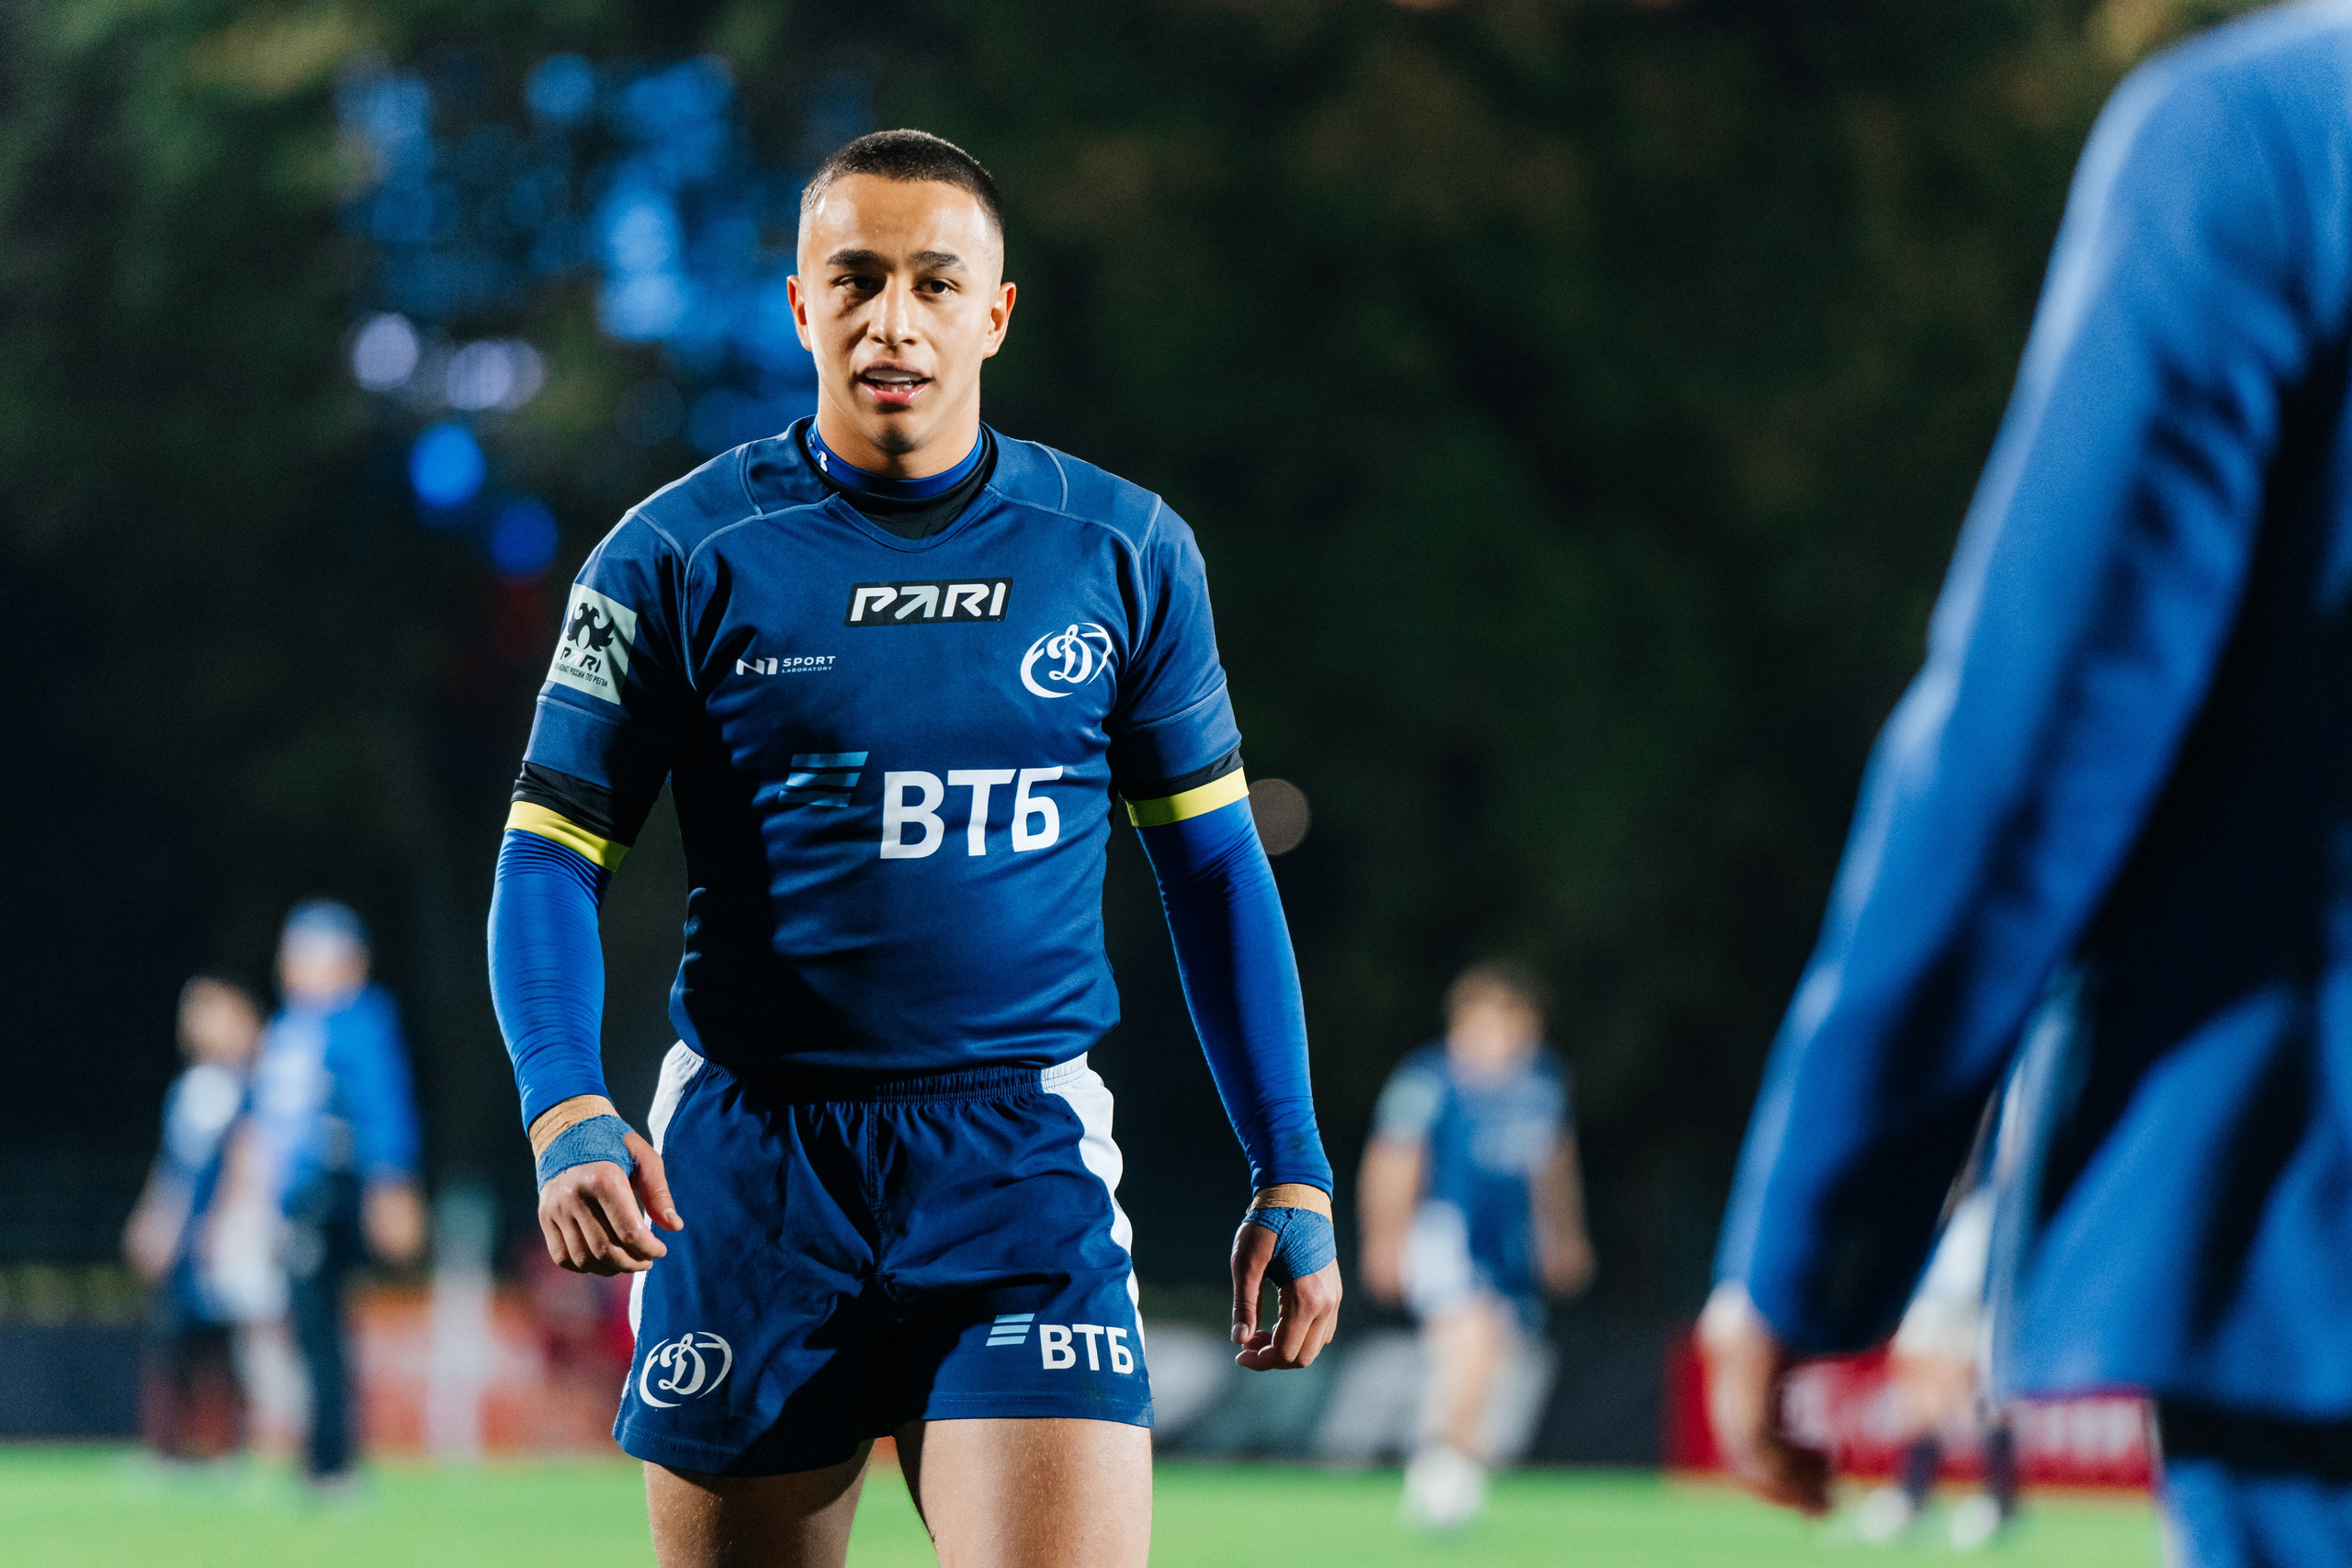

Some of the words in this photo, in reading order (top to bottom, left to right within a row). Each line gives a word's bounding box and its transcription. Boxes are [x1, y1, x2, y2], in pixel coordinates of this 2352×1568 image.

[850, 581, 1007, 622] PARI
[560, 647, 602, 673] PARI
[783, 655, 836, 667] SPORT
[593, 676, 608, 687] РЕГБИ
[879, 765, 1064, 860] ВТБ
[1039, 1324, 1135, 1374] ВТБ
